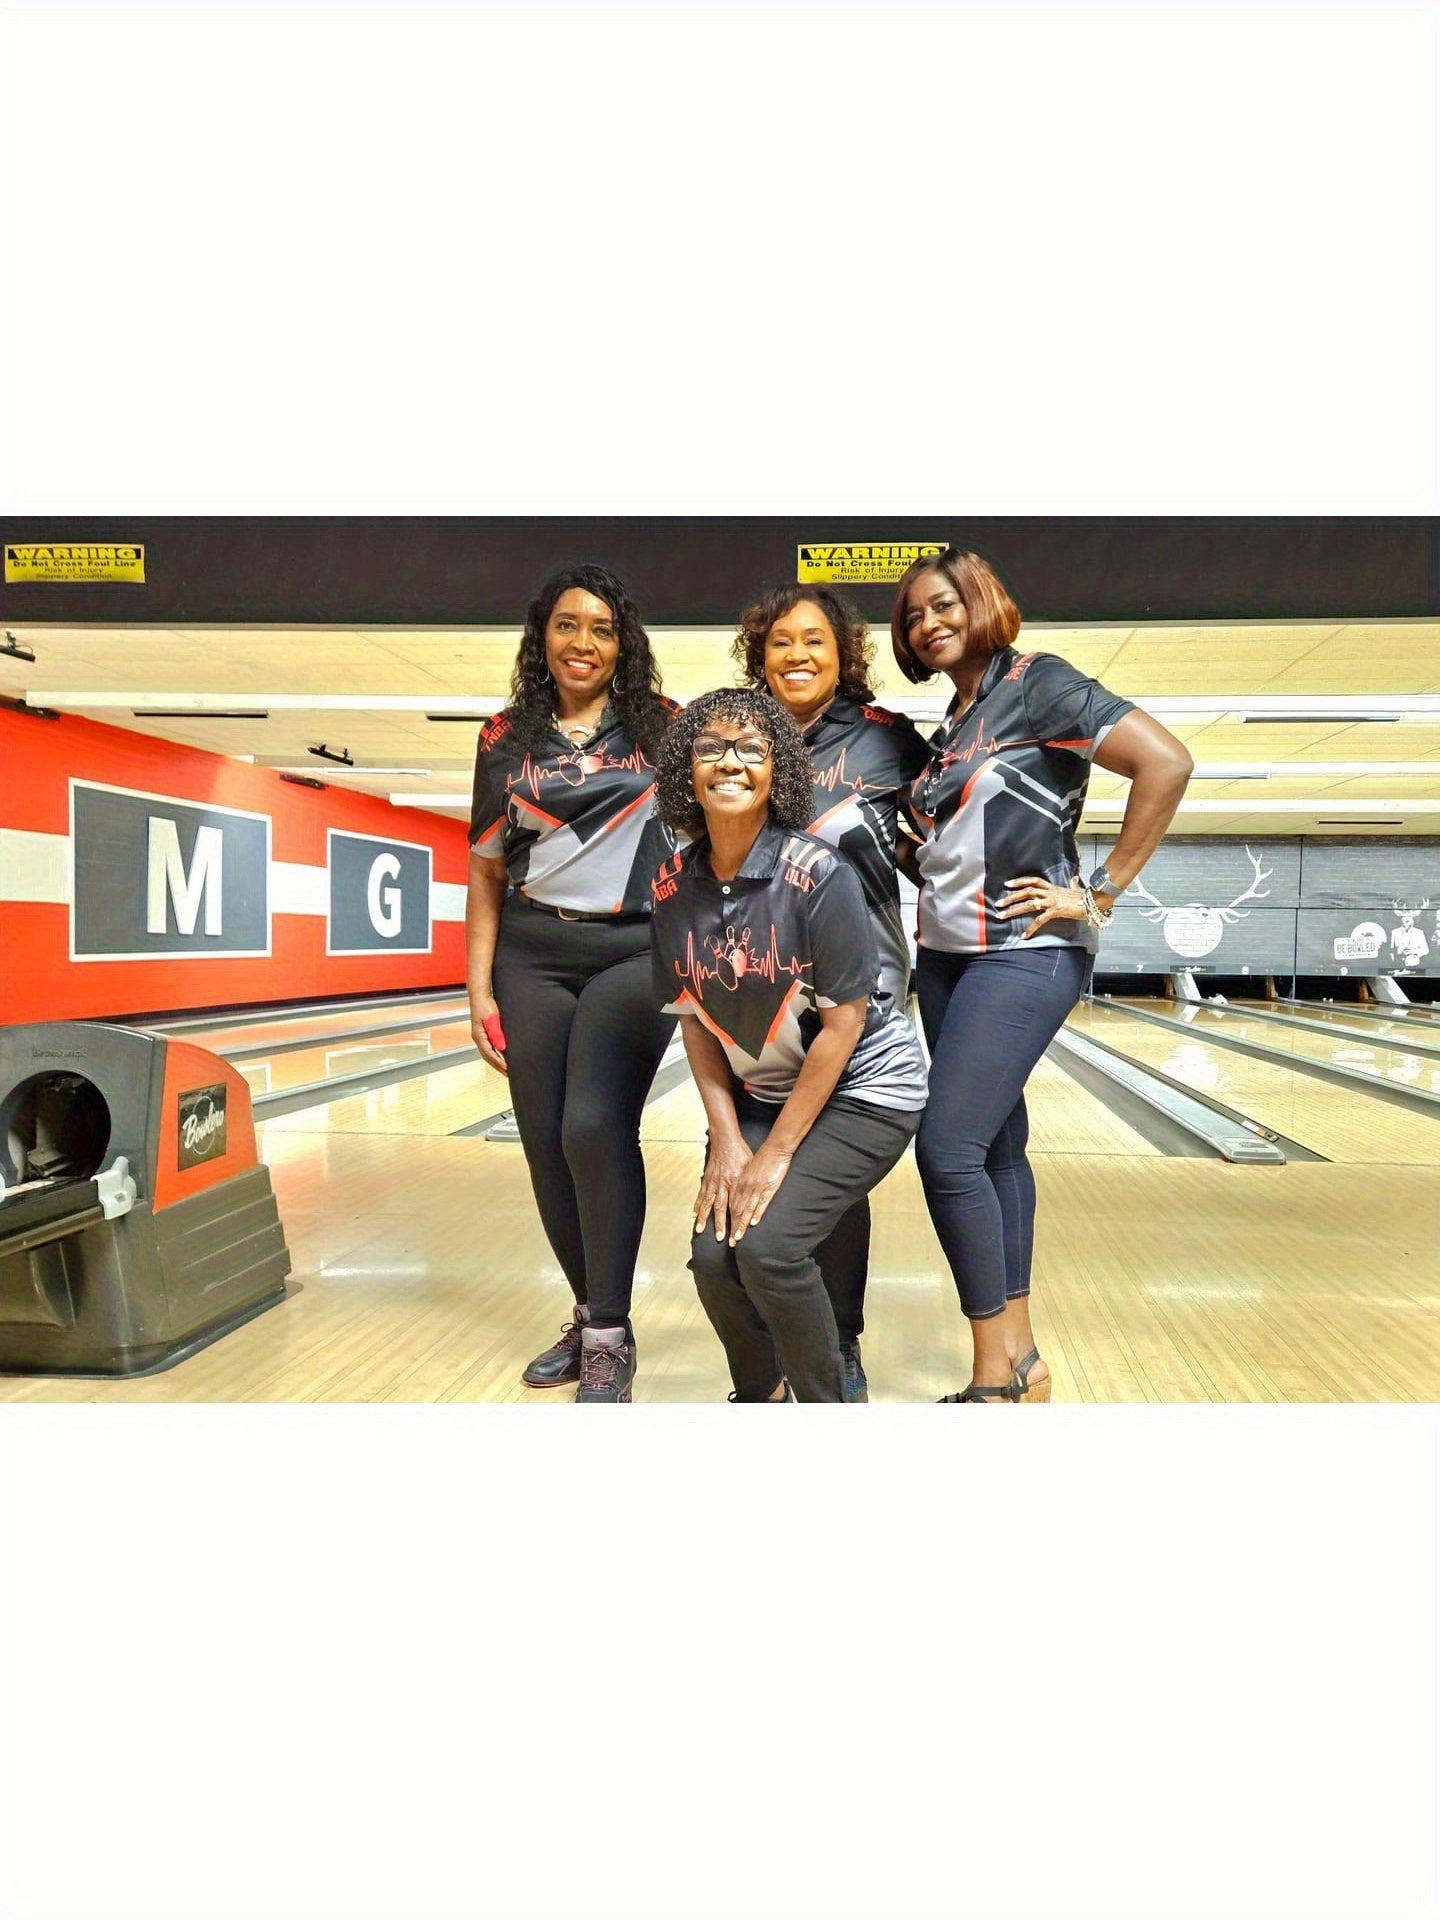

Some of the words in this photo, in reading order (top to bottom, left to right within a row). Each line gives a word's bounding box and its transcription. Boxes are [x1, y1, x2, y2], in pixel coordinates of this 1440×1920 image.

[13, 548, 137, 560] WARNING
[807, 547, 941, 559] WARNING
[878, 567, 905, 575] Injury
[147, 816, 223, 936] M
[367, 852, 401, 938] G
[1136, 965, 1143, 973] 7
[1340, 967, 1348, 976] 9
